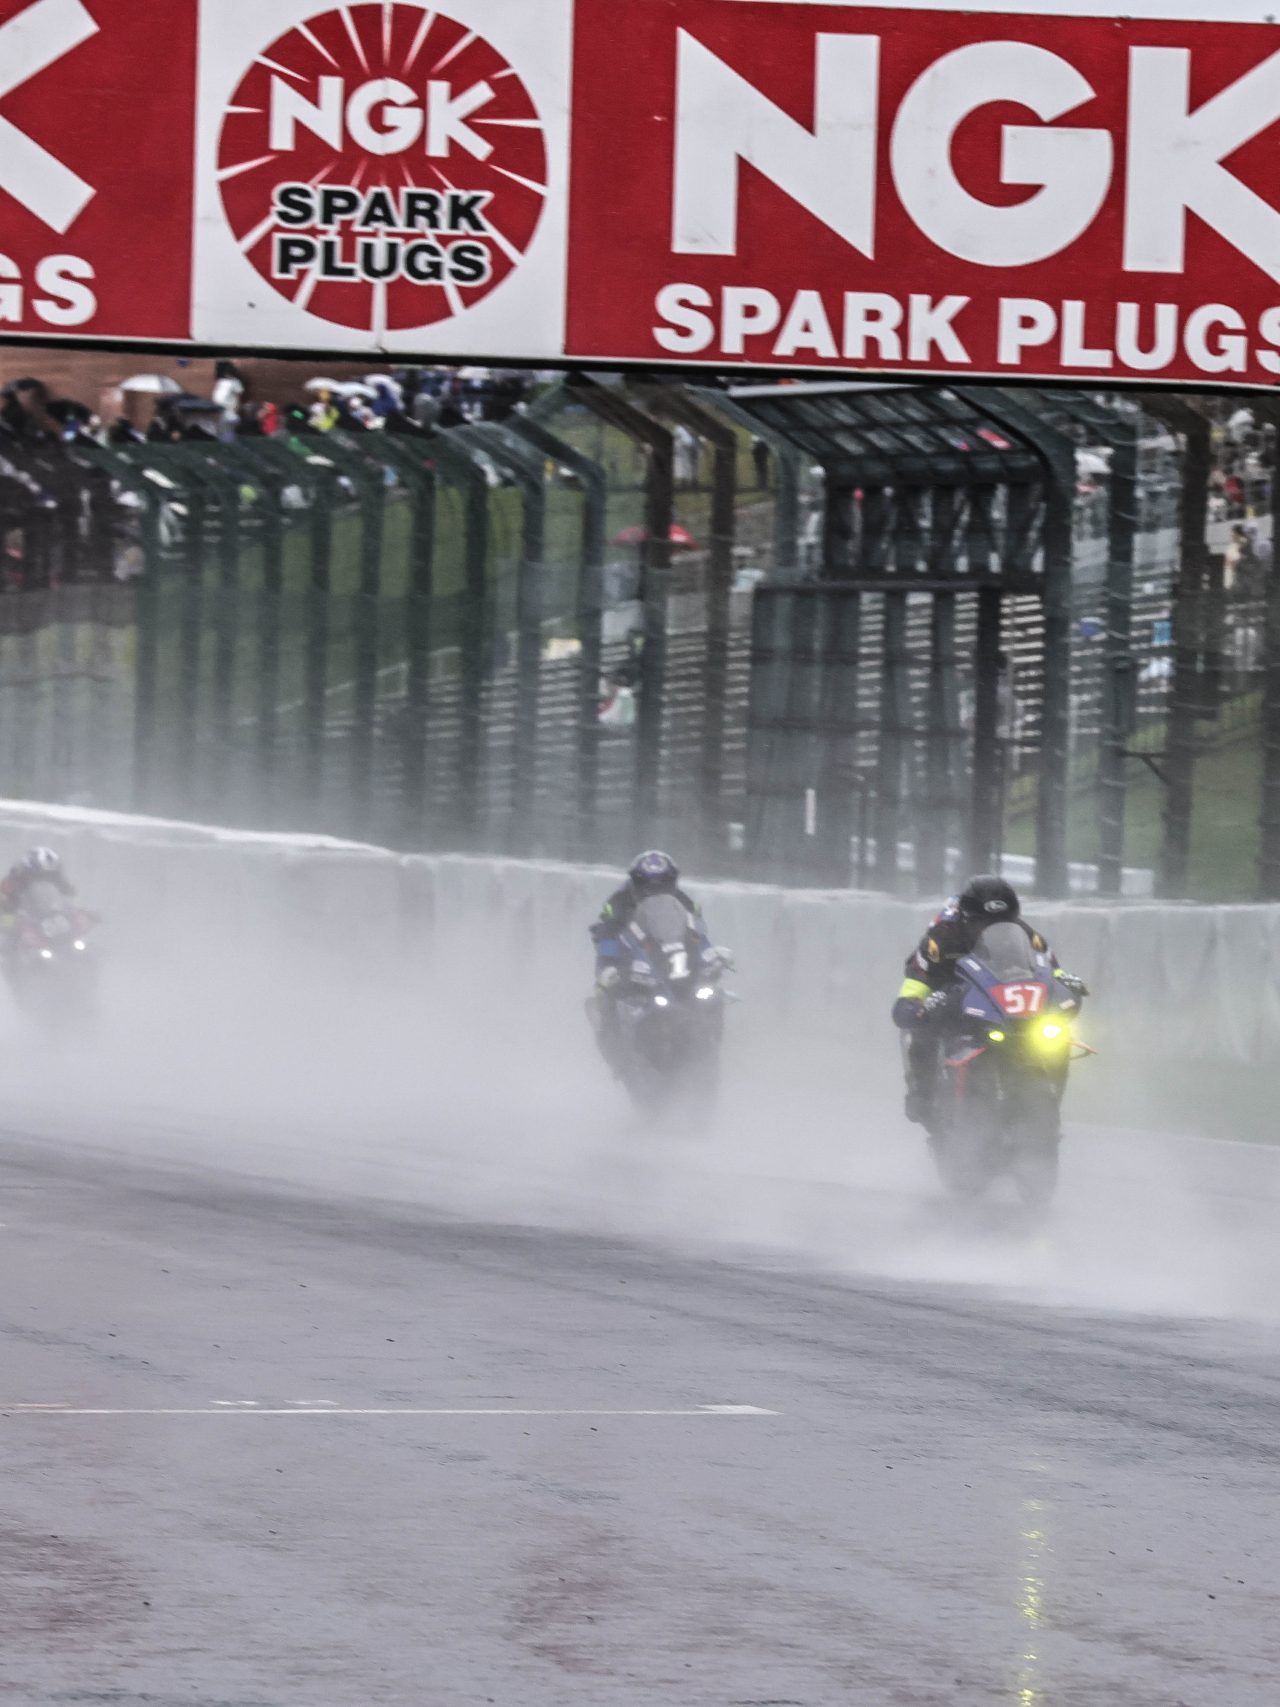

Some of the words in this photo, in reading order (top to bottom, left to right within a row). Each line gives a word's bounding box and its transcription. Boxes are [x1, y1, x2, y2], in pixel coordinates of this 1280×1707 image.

[269, 75, 496, 161] NGK
[277, 187, 486, 231] SPARK
[278, 238, 486, 282] PLUGS
[653, 283, 971, 363] SPARK
[669, 951, 691, 979] 1
[1003, 985, 1042, 1013] 57
